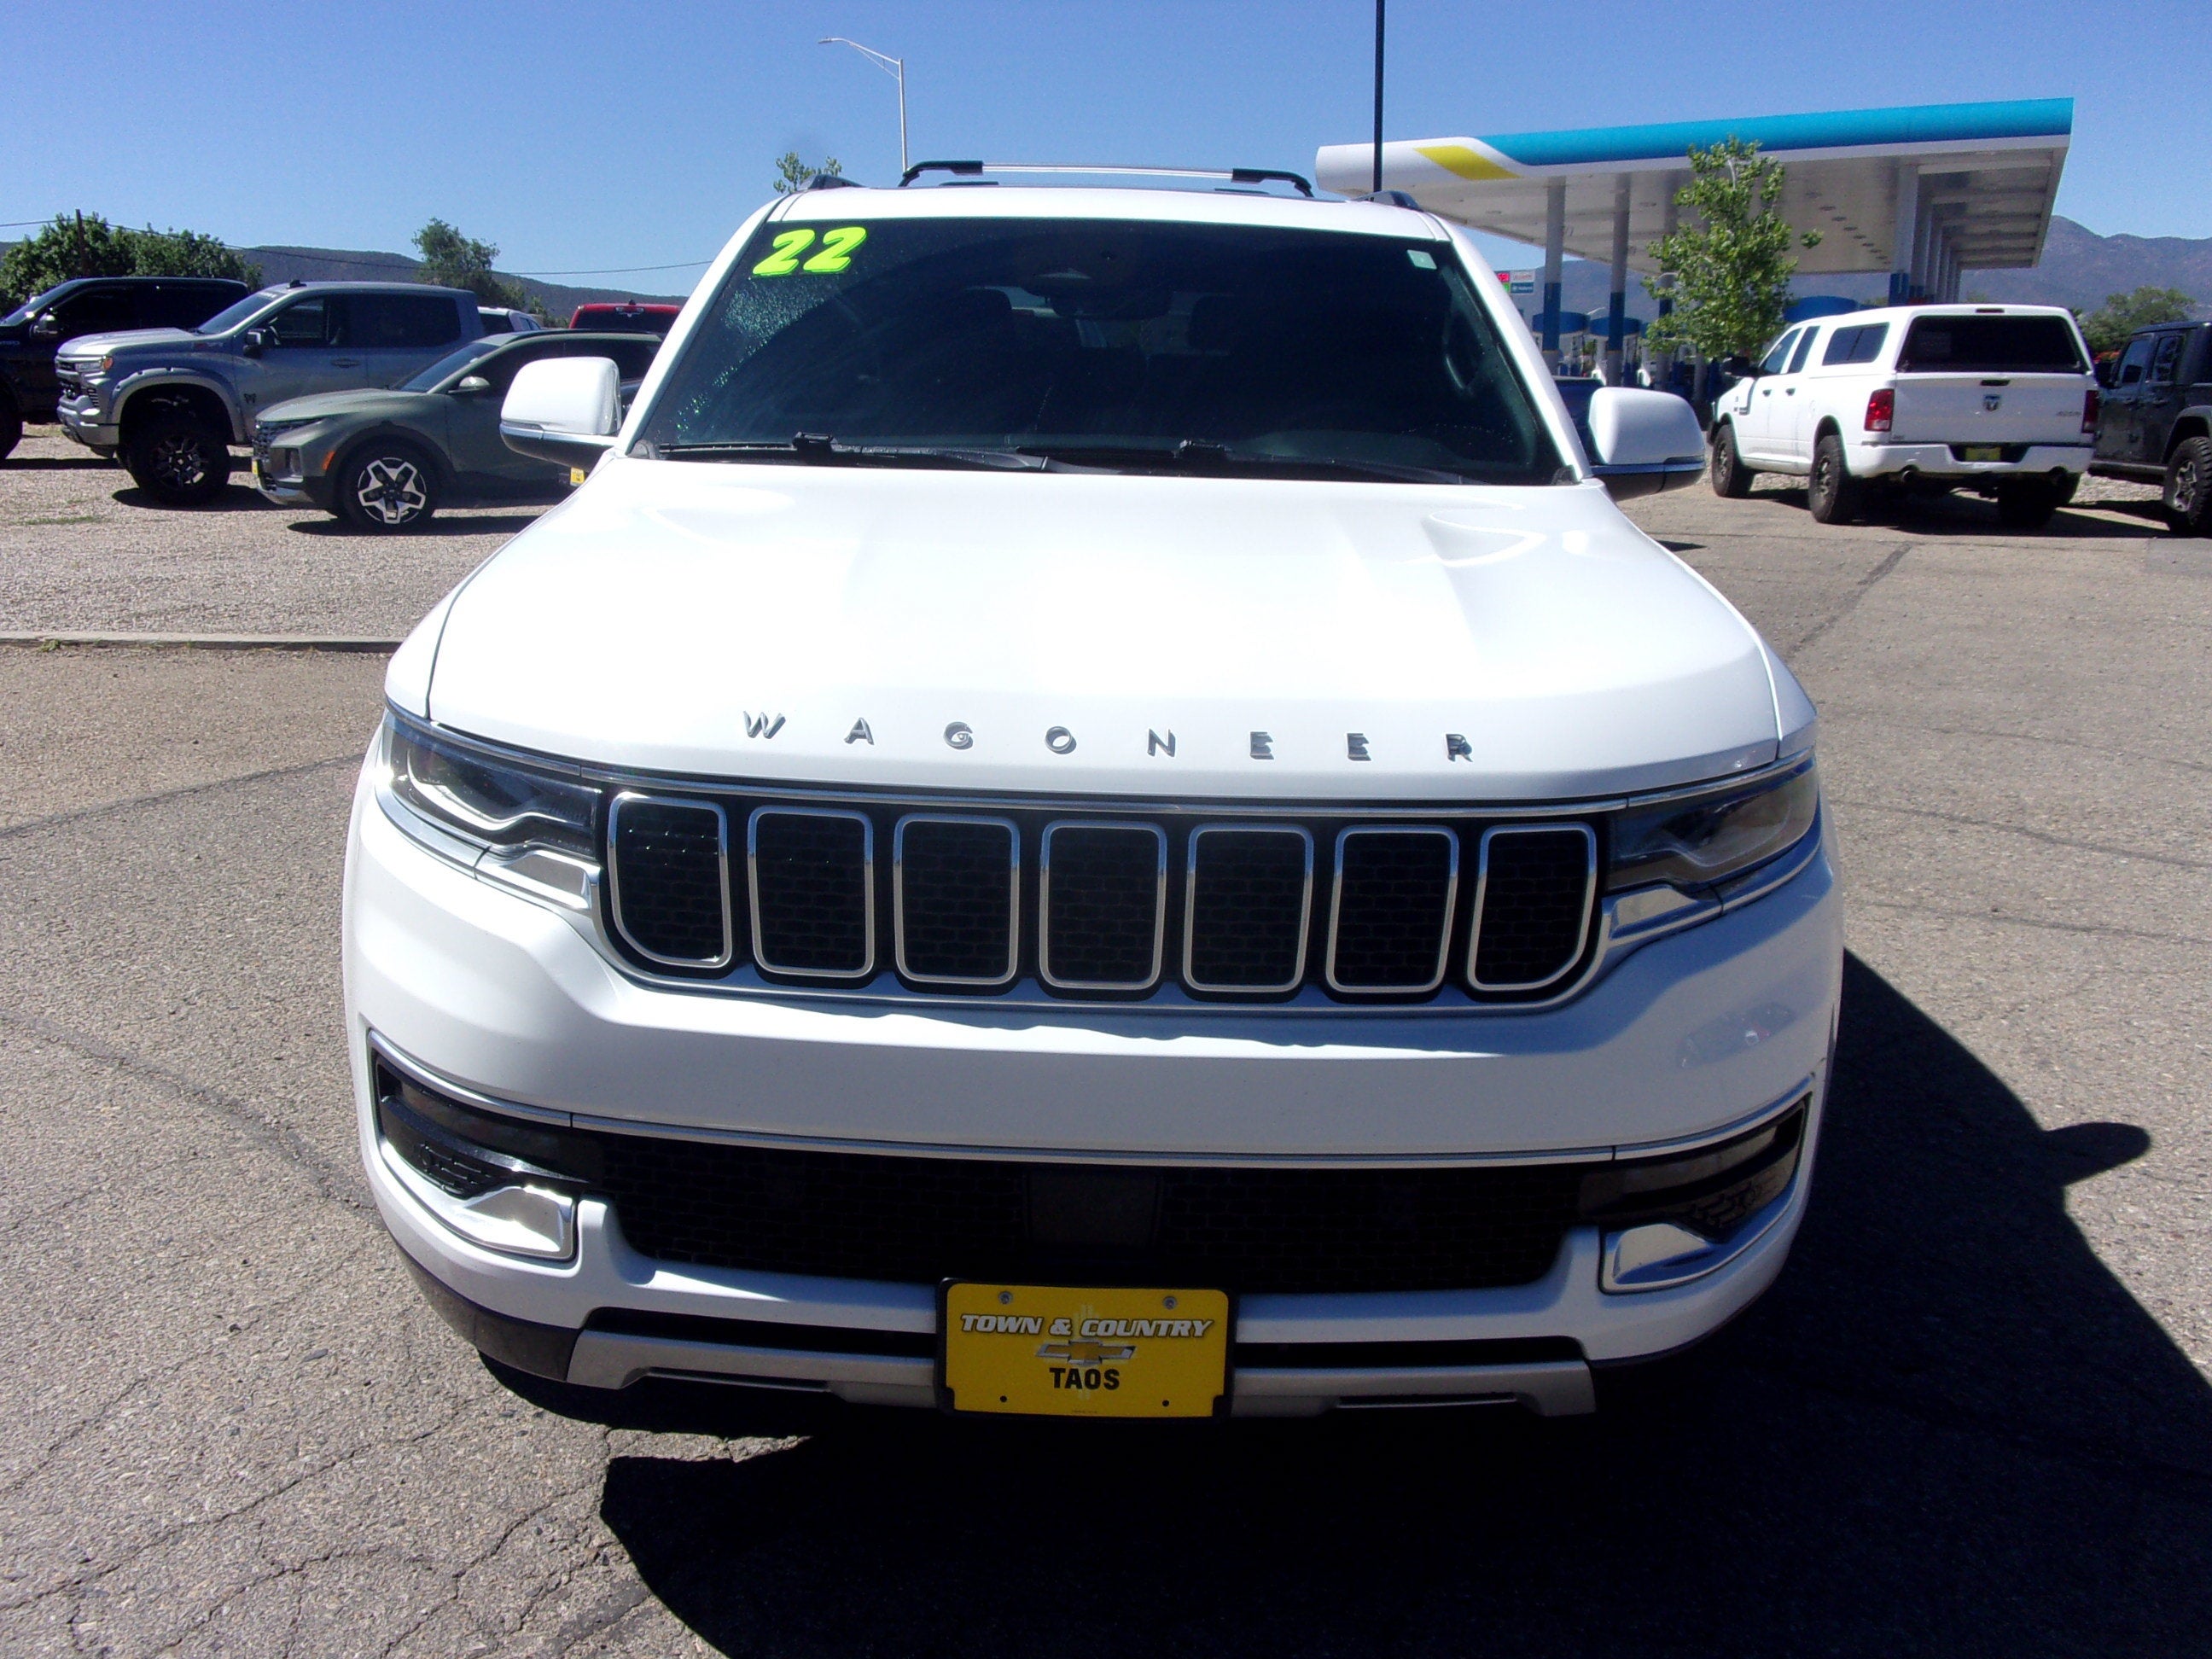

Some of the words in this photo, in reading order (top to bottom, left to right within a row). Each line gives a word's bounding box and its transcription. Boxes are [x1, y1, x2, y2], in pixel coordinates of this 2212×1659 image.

[753, 226, 867, 276] 22
[742, 710, 1475, 762] WAGONEER
[960, 1314, 1043, 1335] TOWN
[1049, 1318, 1073, 1336] &
[1080, 1319, 1213, 1338] COUNTRY
[1049, 1367, 1120, 1390] TAOS
